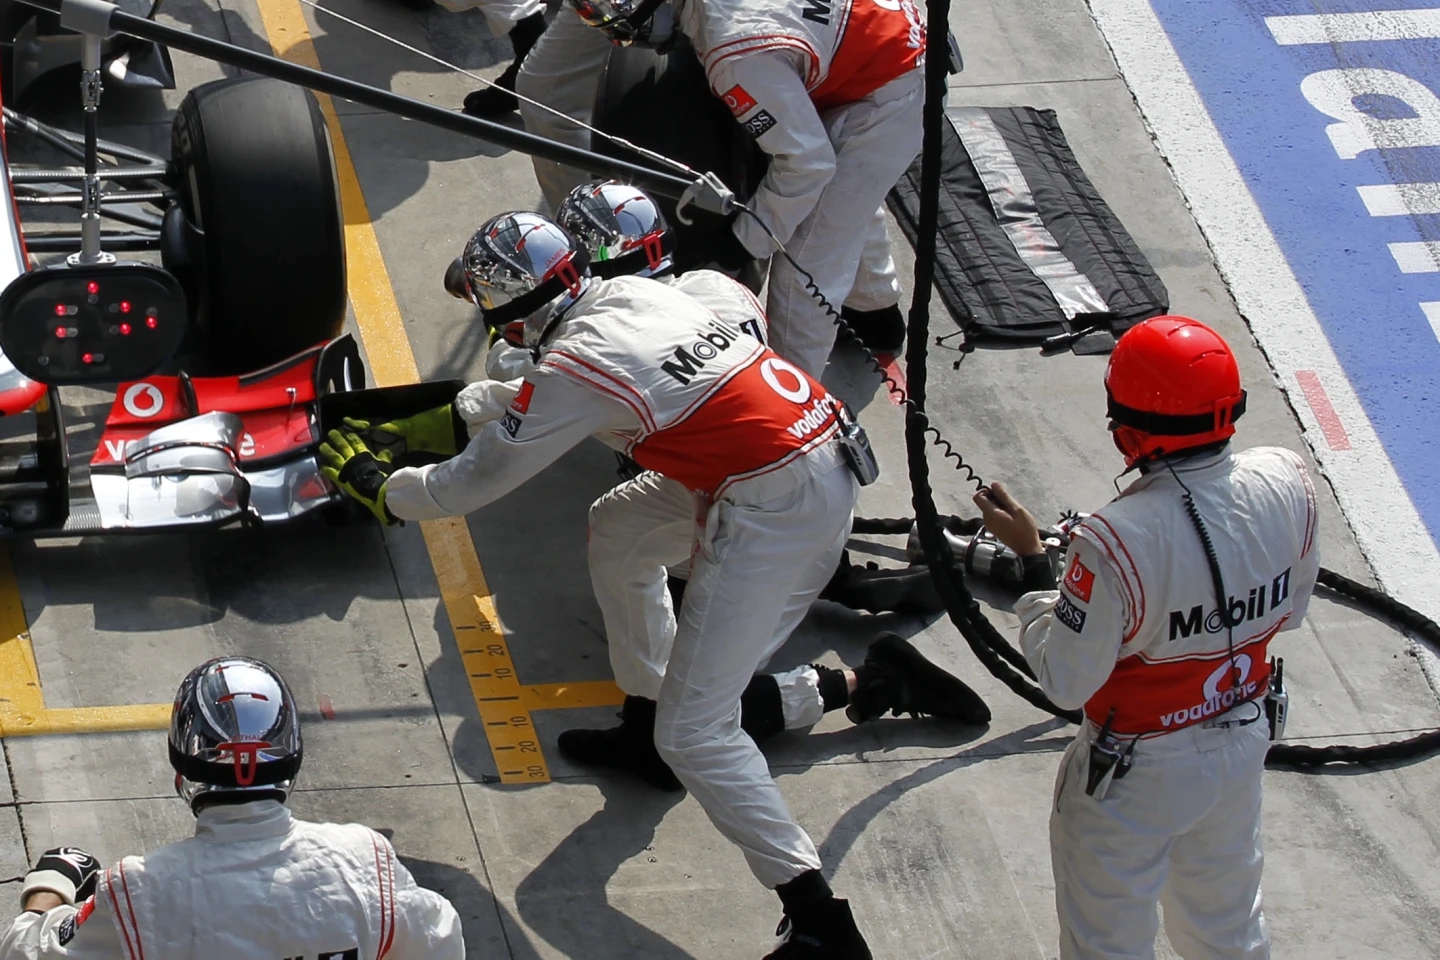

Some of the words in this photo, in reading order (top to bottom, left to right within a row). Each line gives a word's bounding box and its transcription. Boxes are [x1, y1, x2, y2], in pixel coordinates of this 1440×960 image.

[660, 319, 740, 386] Mobil
[1168, 585, 1266, 642] Mobil
[487, 644, 505, 657] 20
[494, 667, 513, 680] 10
[510, 716, 528, 728] 10
[518, 740, 537, 753] 20
[527, 765, 545, 778] 30
